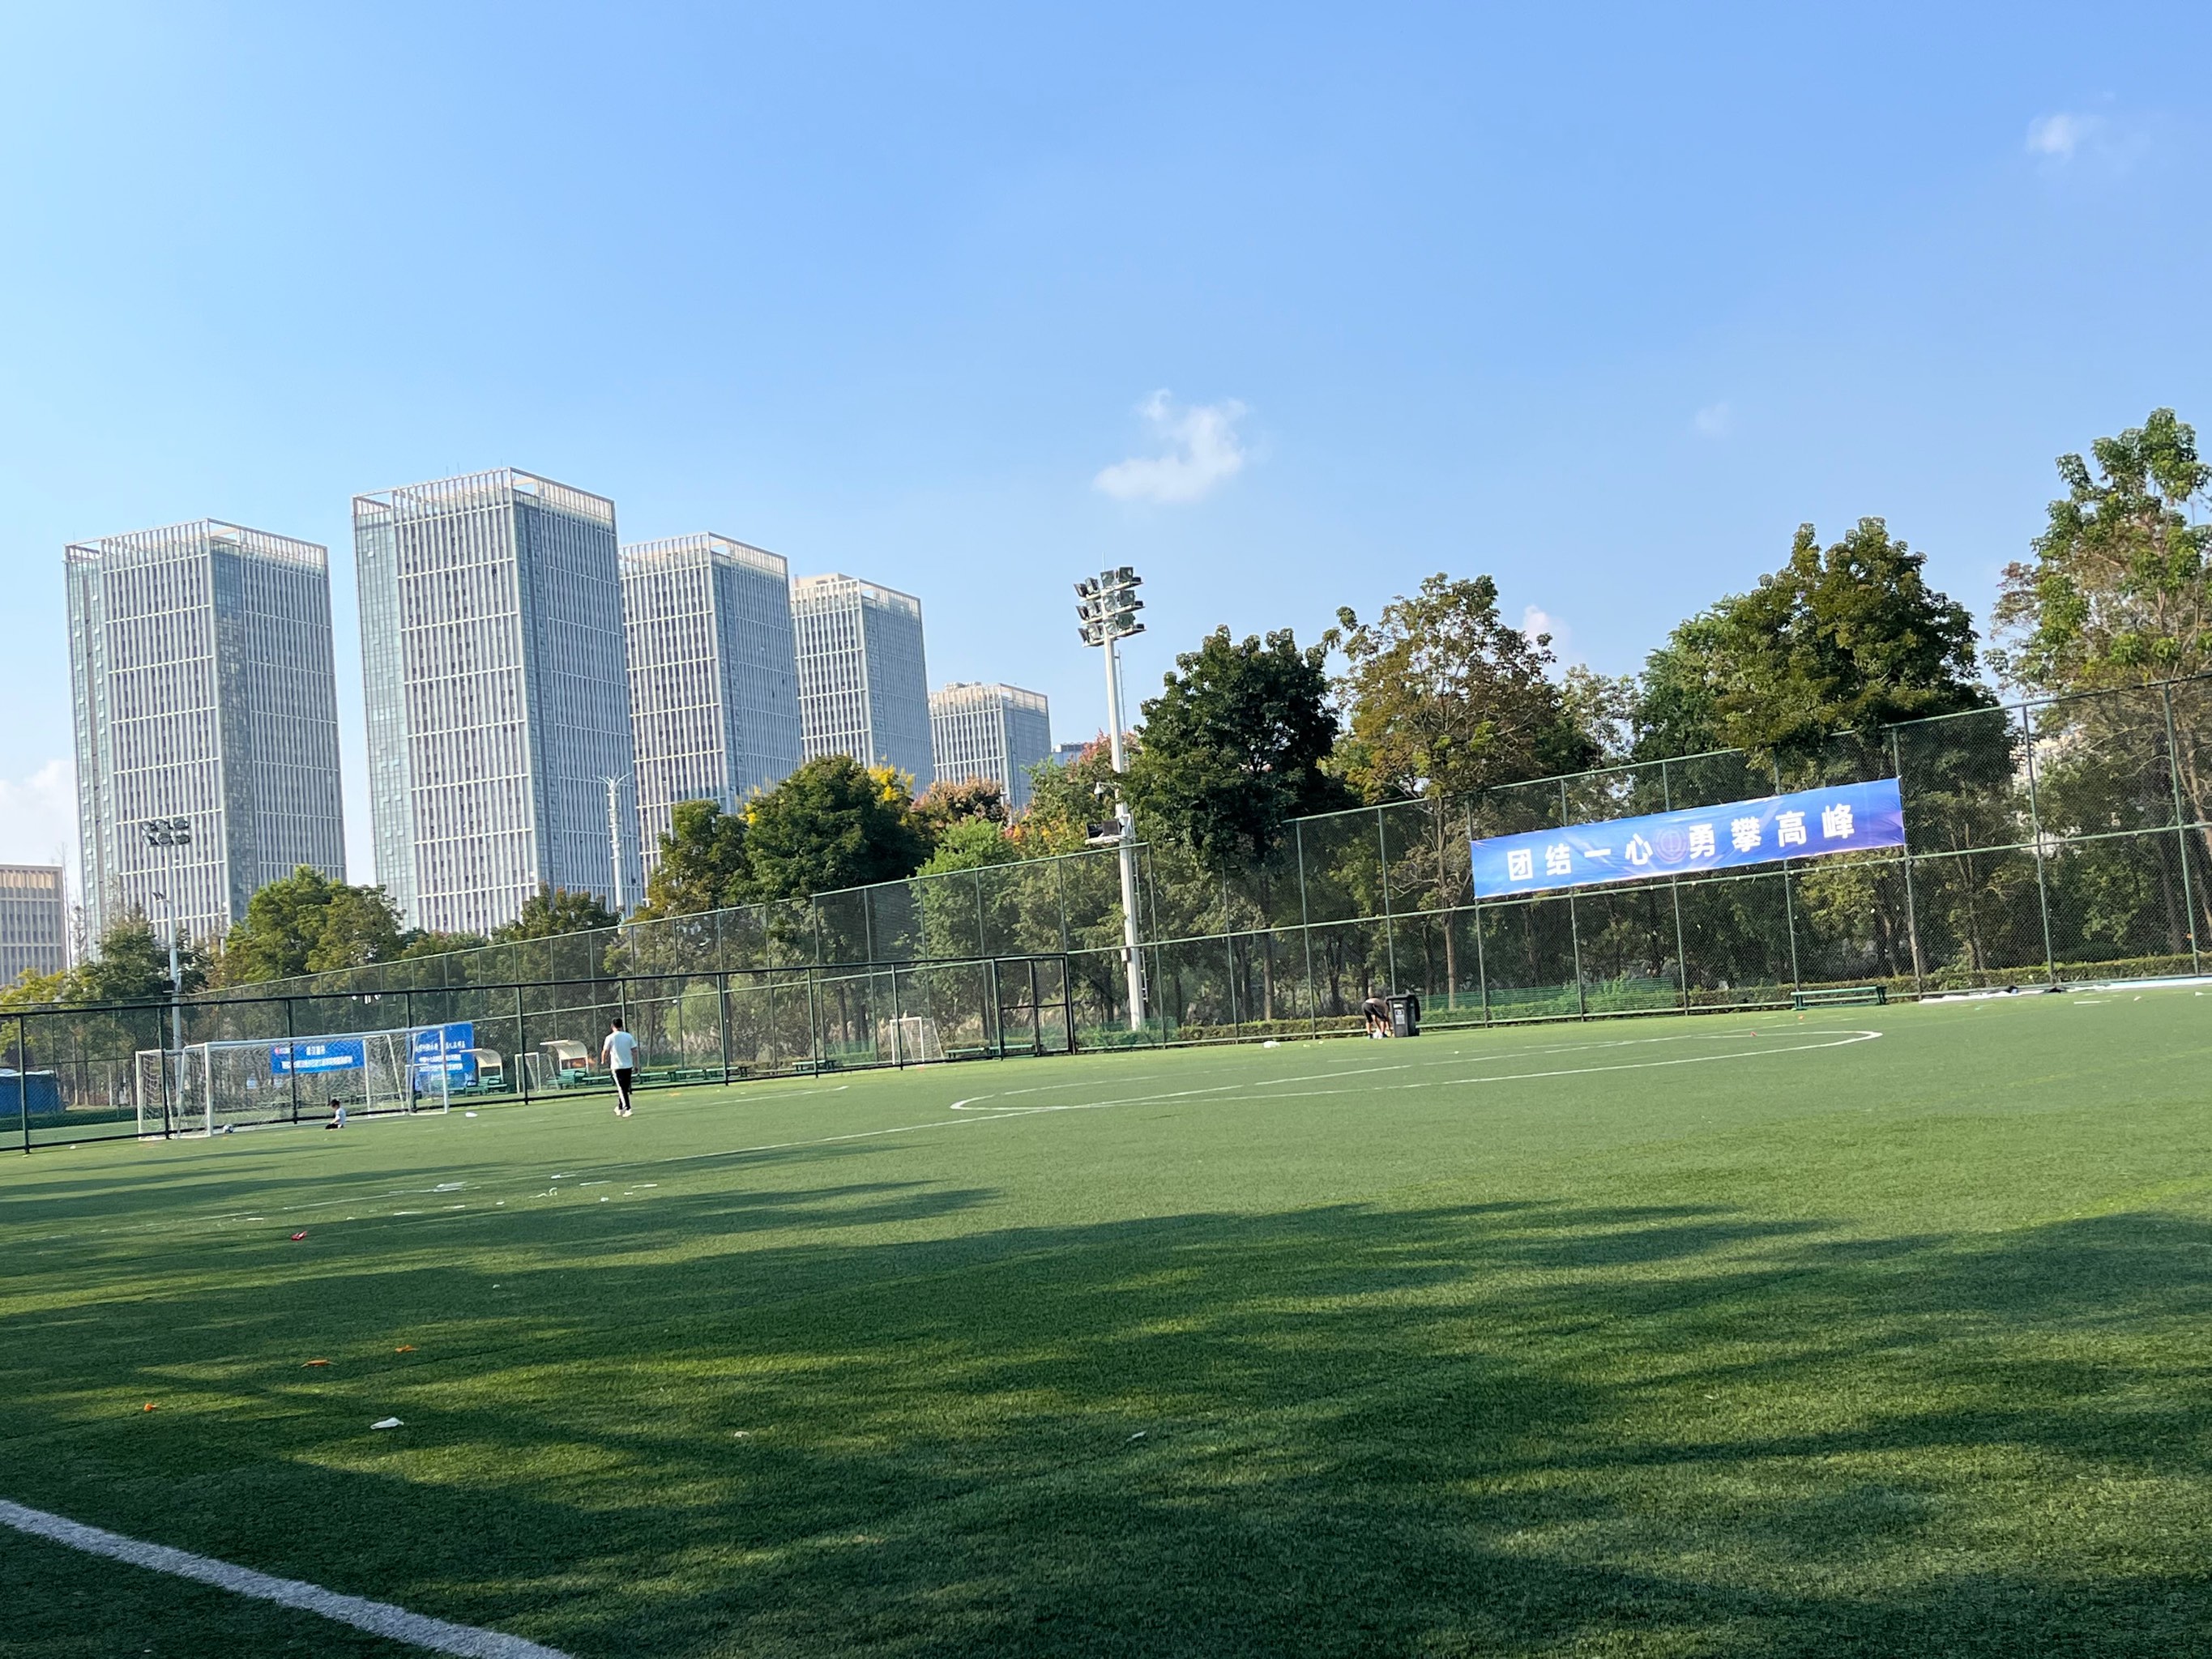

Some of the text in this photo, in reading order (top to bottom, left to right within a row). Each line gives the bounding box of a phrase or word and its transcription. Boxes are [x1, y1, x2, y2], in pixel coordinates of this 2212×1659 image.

[1507, 803, 1855, 881] 团结一心 勇攀高峰
